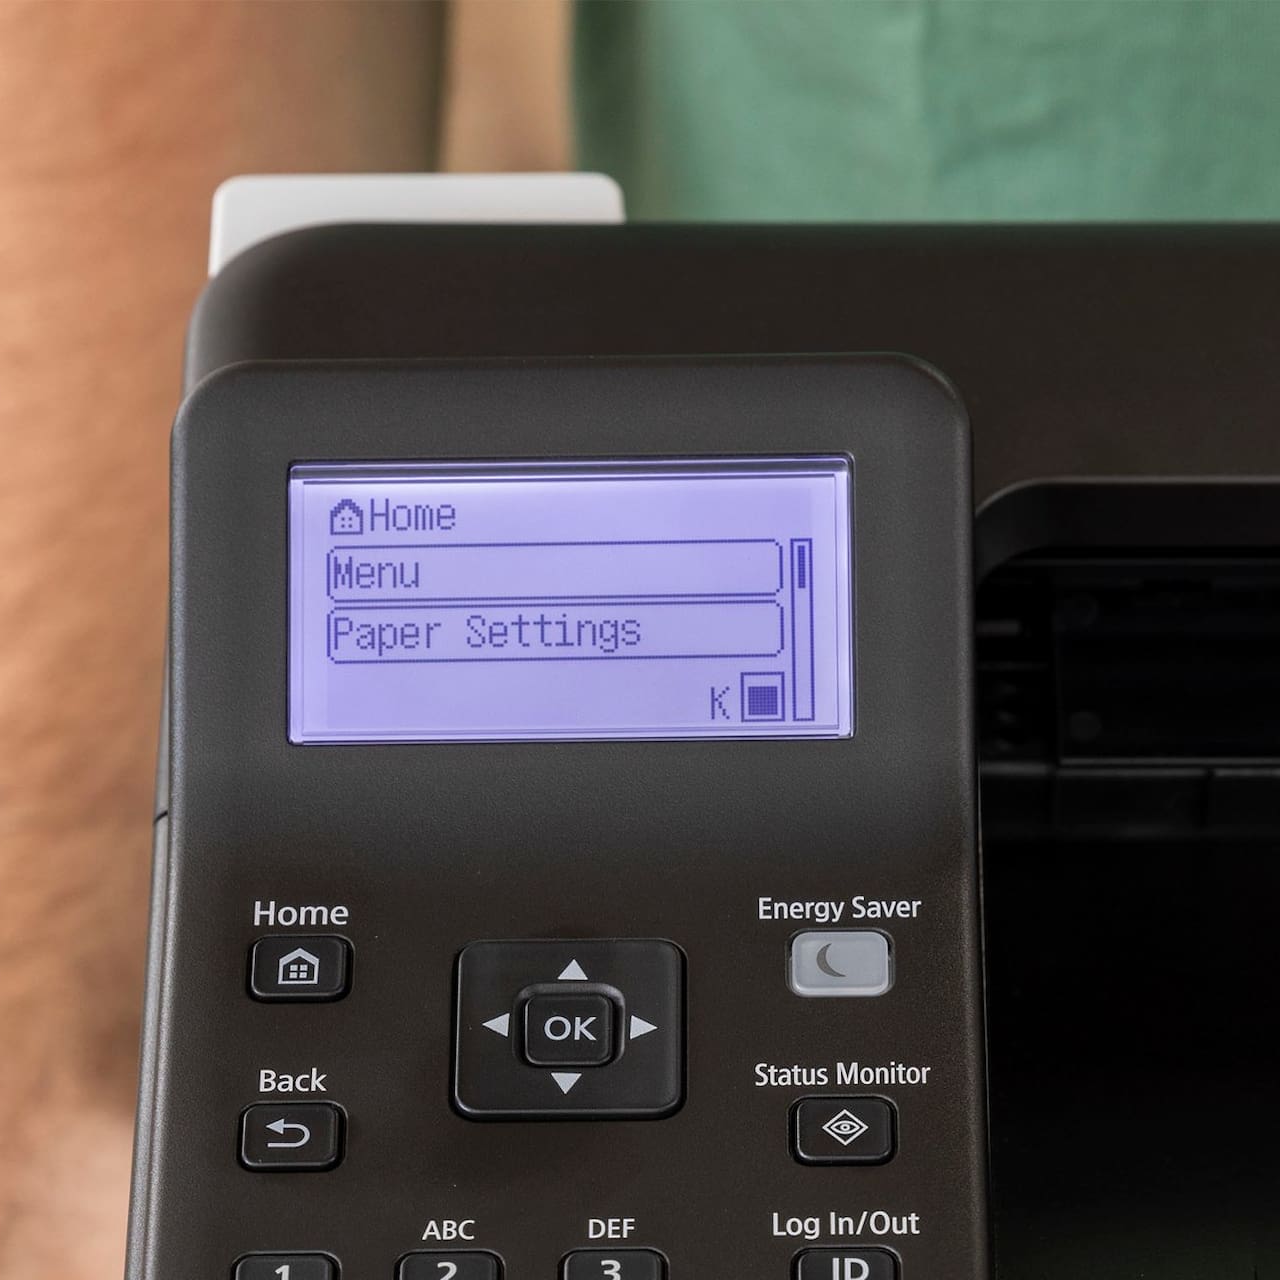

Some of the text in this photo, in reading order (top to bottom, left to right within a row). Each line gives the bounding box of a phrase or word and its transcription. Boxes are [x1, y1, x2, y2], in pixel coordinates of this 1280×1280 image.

[370, 498, 456, 532] Home
[333, 555, 420, 590] Menu
[332, 613, 642, 657] Paper Settings
[710, 686, 730, 720] K
[253, 900, 349, 926] Home
[758, 895, 922, 923] Energy Saver
[544, 1016, 597, 1041] OK
[259, 1067, 327, 1092] Back
[754, 1061, 931, 1087] Status Monitor
[421, 1219, 475, 1241] ABC
[588, 1218, 635, 1239] DEF
[772, 1210, 920, 1240] Log In/Out
